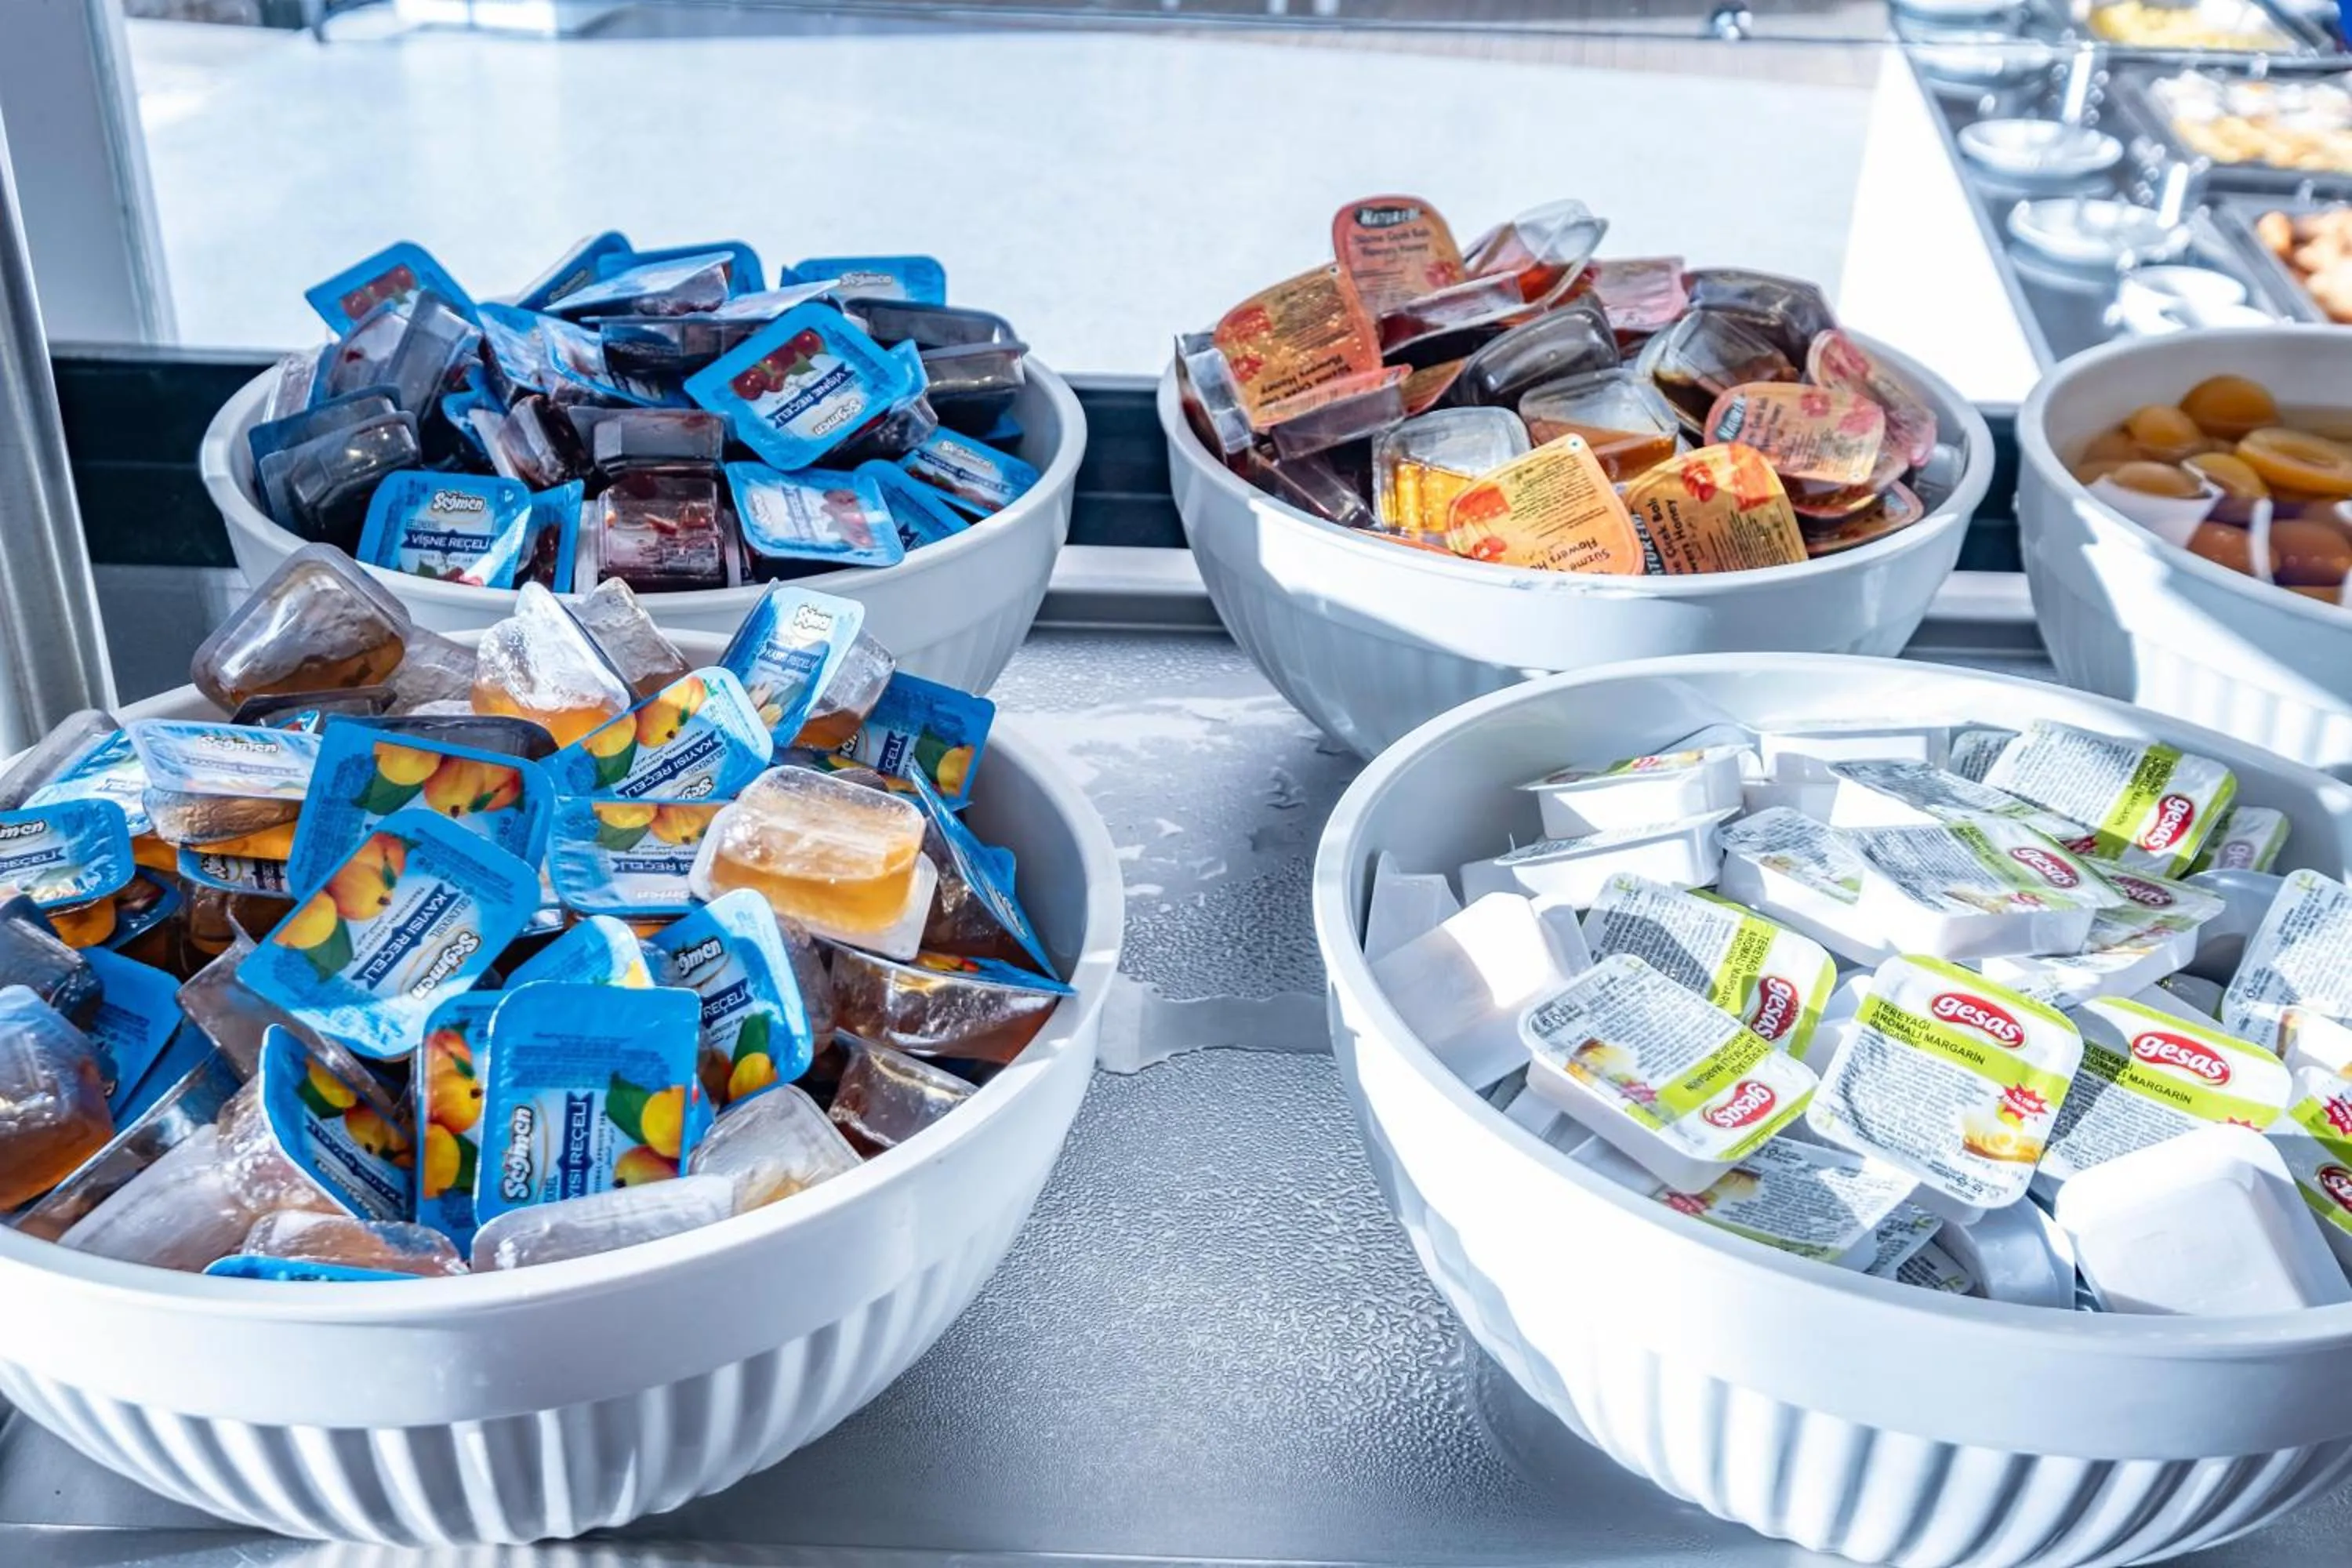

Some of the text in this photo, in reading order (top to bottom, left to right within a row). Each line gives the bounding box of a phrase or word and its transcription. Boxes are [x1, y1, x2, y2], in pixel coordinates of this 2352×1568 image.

[1661, 495, 1690, 541] Honey
[412, 533, 490, 551] VİŞNE REÇELİ
[1548, 535, 1599, 567] Flowers
[671, 739, 714, 769] KAYISI
[882, 737, 903, 773] ÇELİ
[622, 762, 673, 797] REÇELİ
[0, 822, 45, 838] men
[2148, 795, 2190, 851] gesas
[2013, 848, 2077, 886] gesas
[405, 891, 448, 936] KAYISI
[363, 935, 411, 982] REÇELİ
[410, 931, 481, 1000] Seğmen
[677, 938, 722, 975] ğmen
[1752, 977, 1792, 1041] gesas
[1875, 1001, 1932, 1032] TEREYAĞI
[1934, 996, 2020, 1042] gesas
[1870, 1009, 1987, 1065] AROMALI MARGARİN
[2134, 1034, 2228, 1079] gesas
[1714, 1081, 1772, 1129] gesas
[2127, 1070, 2194, 1105] MARGARİN
[503, 1105, 534, 1202] Seğmen
[568, 1100, 591, 1198] YISI REÇELİ
